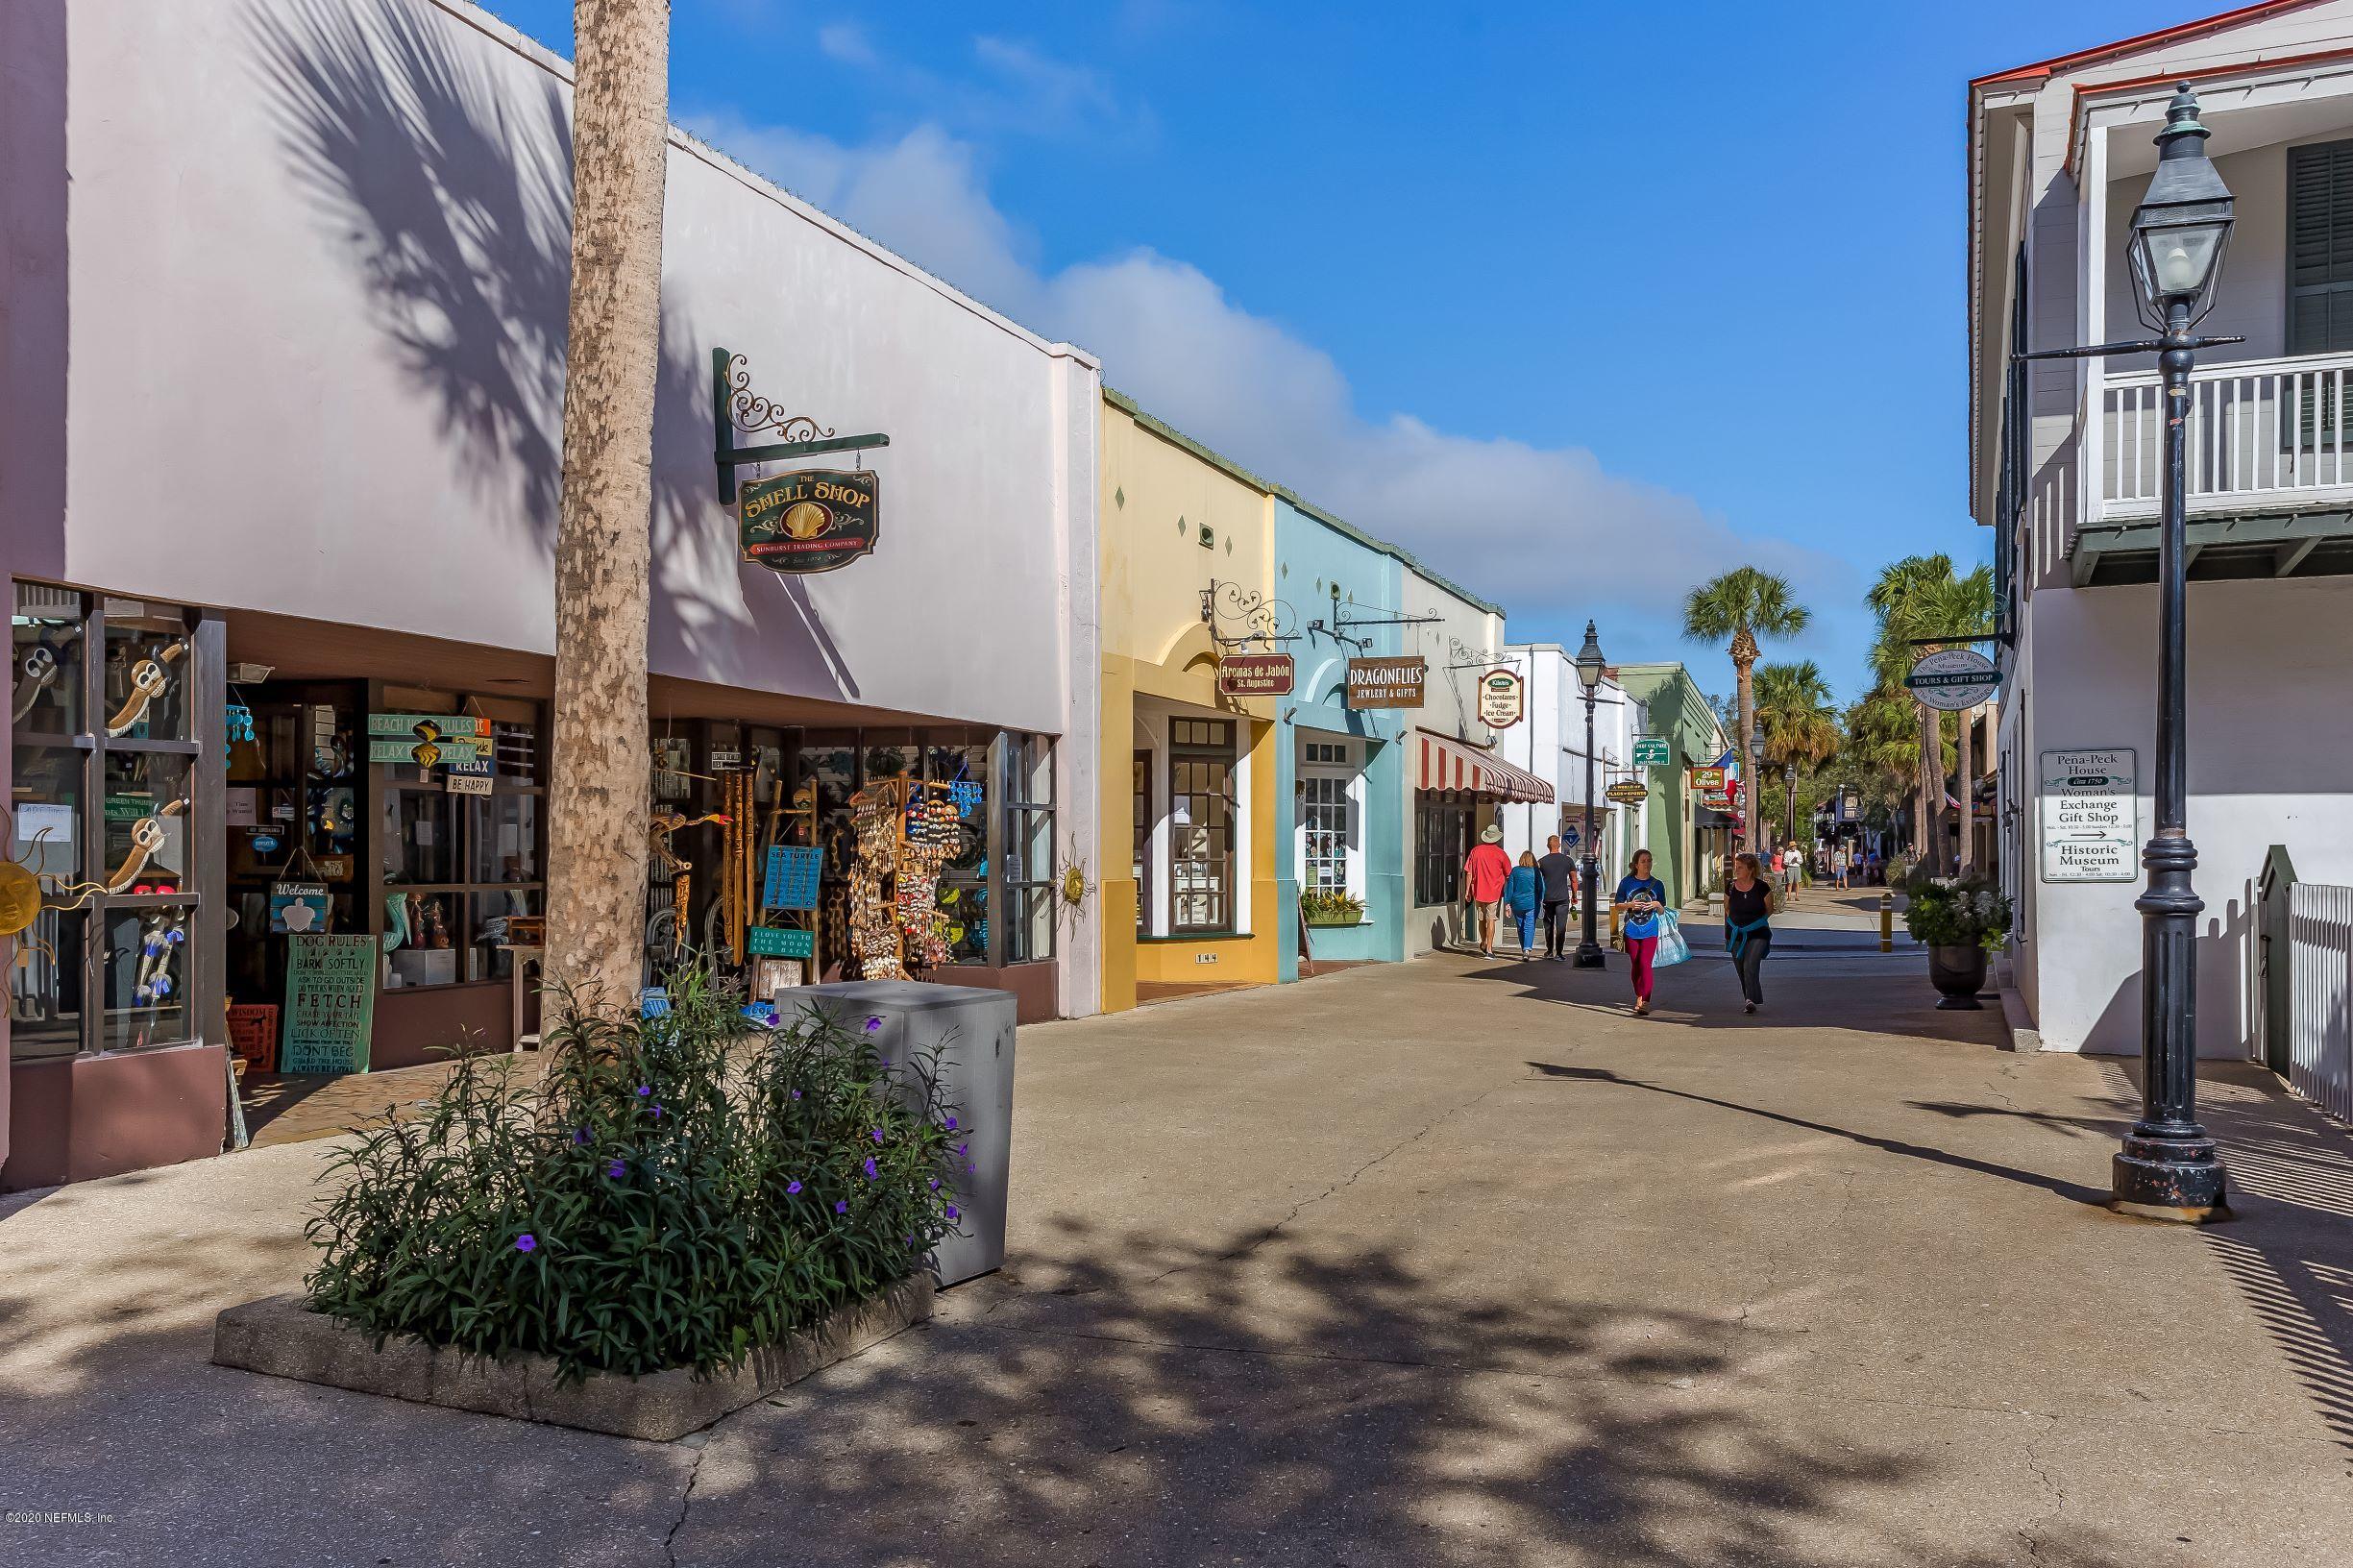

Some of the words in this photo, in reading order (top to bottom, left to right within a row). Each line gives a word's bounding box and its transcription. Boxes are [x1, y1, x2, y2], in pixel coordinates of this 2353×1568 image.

[745, 484, 807, 518] SHELL
[814, 481, 870, 508] SHOP
[824, 540, 858, 549] COMPANY
[1918, 663, 1930, 674] The
[1967, 653, 1989, 670] House
[1222, 666, 1253, 678] Aromas
[1255, 666, 1263, 677] de
[1265, 664, 1289, 677] Jabón
[1350, 667, 1423, 686] DRAGONFLIES
[1237, 679, 1246, 688] St.
[1246, 679, 1275, 688] Augustine
[1915, 677, 1941, 686] TOURS
[1357, 688, 1386, 698] JEWLERY
[1389, 689, 1394, 698] &
[1396, 688, 1416, 698] GIFTS
[1918, 690, 1928, 699] The
[1929, 697, 1960, 708] Woman's
[1961, 687, 1992, 706] Exchange
[371, 719, 403, 732] BEACH
[442, 720, 472, 733] RULES
[370, 744, 405, 759] RELAX
[441, 746, 475, 760] RELAX
[2057, 754, 2118, 765] Peña-Peck
[2069, 767, 2107, 775] House
[453, 779, 462, 790] BE
[465, 780, 489, 792] HAPPY
[2061, 788, 2117, 797] Woman's
[2060, 800, 2118, 812] Exchange
[2059, 813, 2083, 822] Gift
[2087, 813, 2119, 824] Shop
[2061, 845, 2118, 855] Historic
[2059, 855, 2120, 866] Museum
[277, 883, 324, 895] Welcome
[296, 936, 324, 947] DOG
[328, 936, 366, 947] RULES
[1197, 953, 1216, 963] 144
[297, 959, 322, 969] BARK
[328, 959, 365, 969] SOFTLY
[297, 993, 362, 1009] FETCH
[232, 1008, 266, 1017] WISDOM
[290, 1028, 317, 1038] LICK
[320, 1029, 360, 1039] OFTEN
[331, 1045, 355, 1057] BEG
